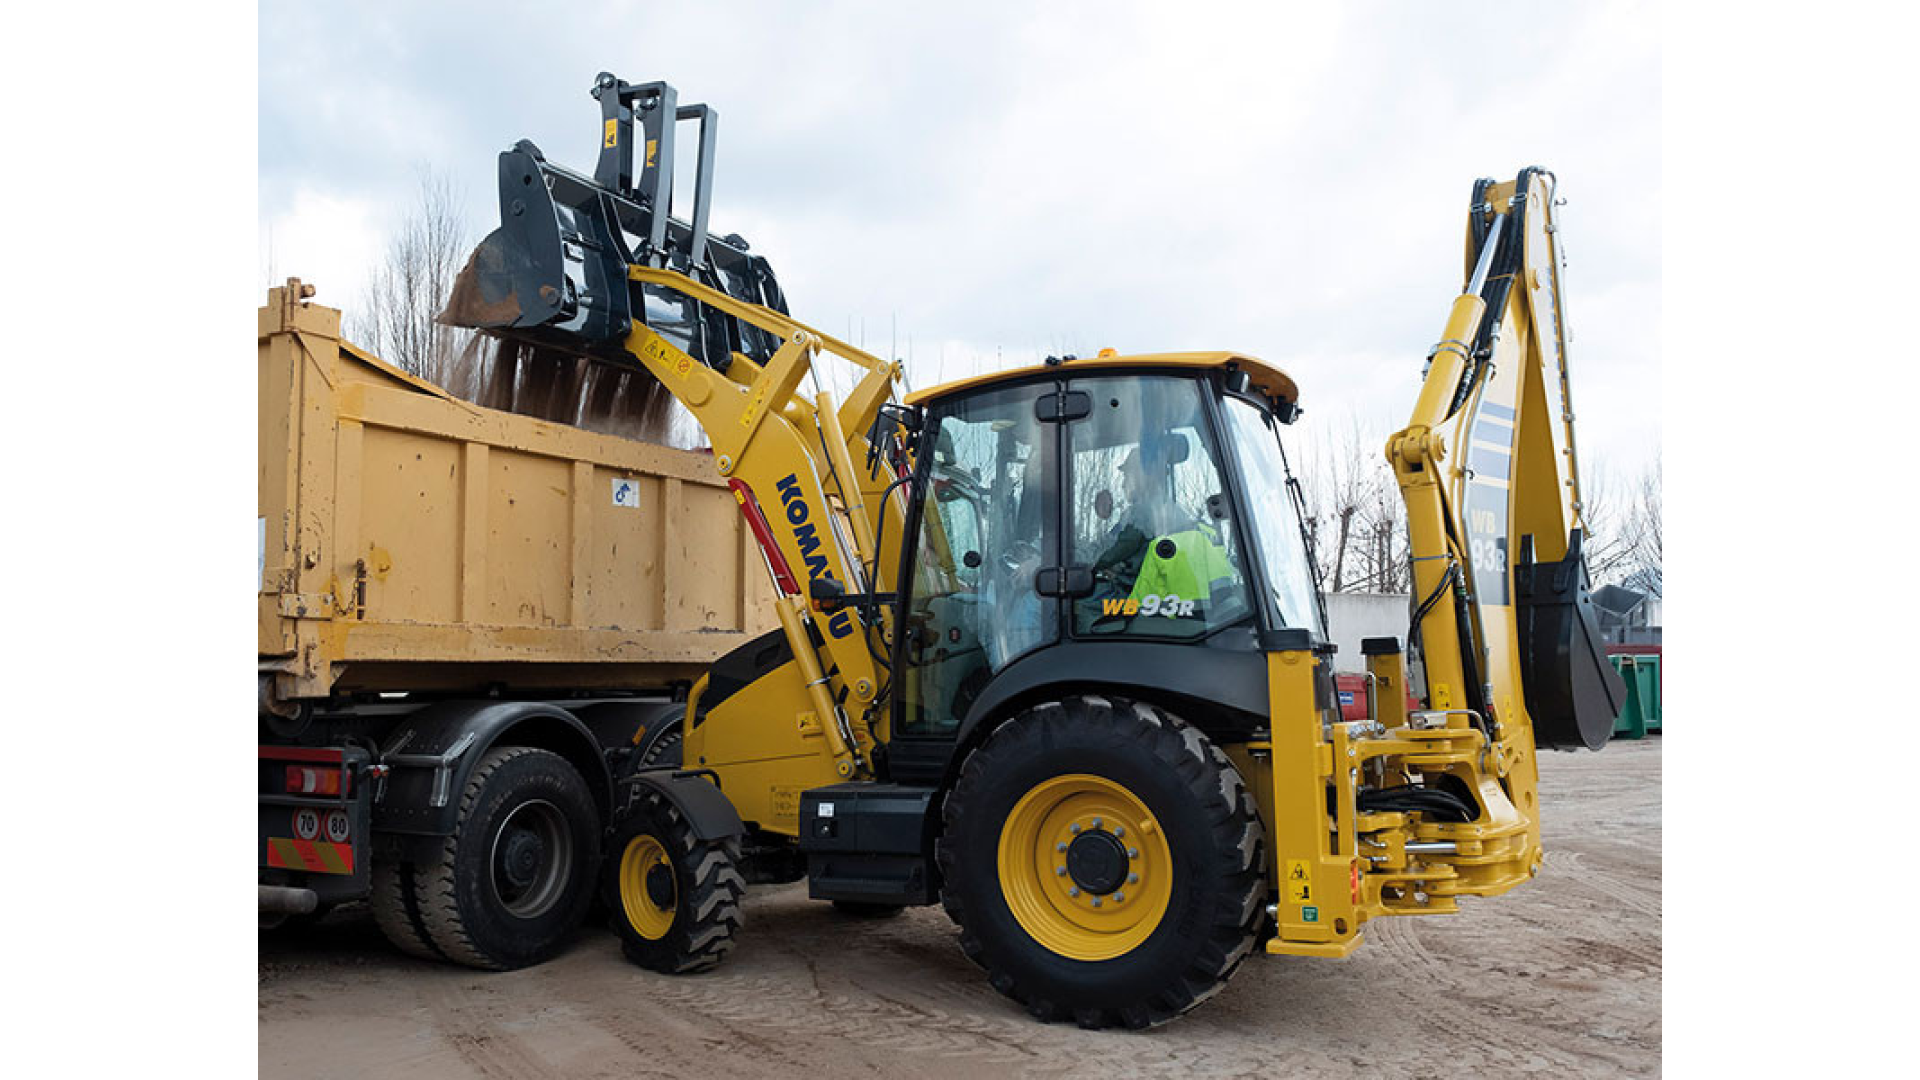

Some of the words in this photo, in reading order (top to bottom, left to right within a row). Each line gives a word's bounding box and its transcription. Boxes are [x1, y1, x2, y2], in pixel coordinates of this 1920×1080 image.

[1471, 508, 1496, 534] WB
[776, 473, 853, 639] KOMAU
[1471, 538, 1506, 572] 93R
[1102, 594, 1195, 617] WB93R
[300, 814, 315, 833] 70
[331, 816, 347, 836] 80
